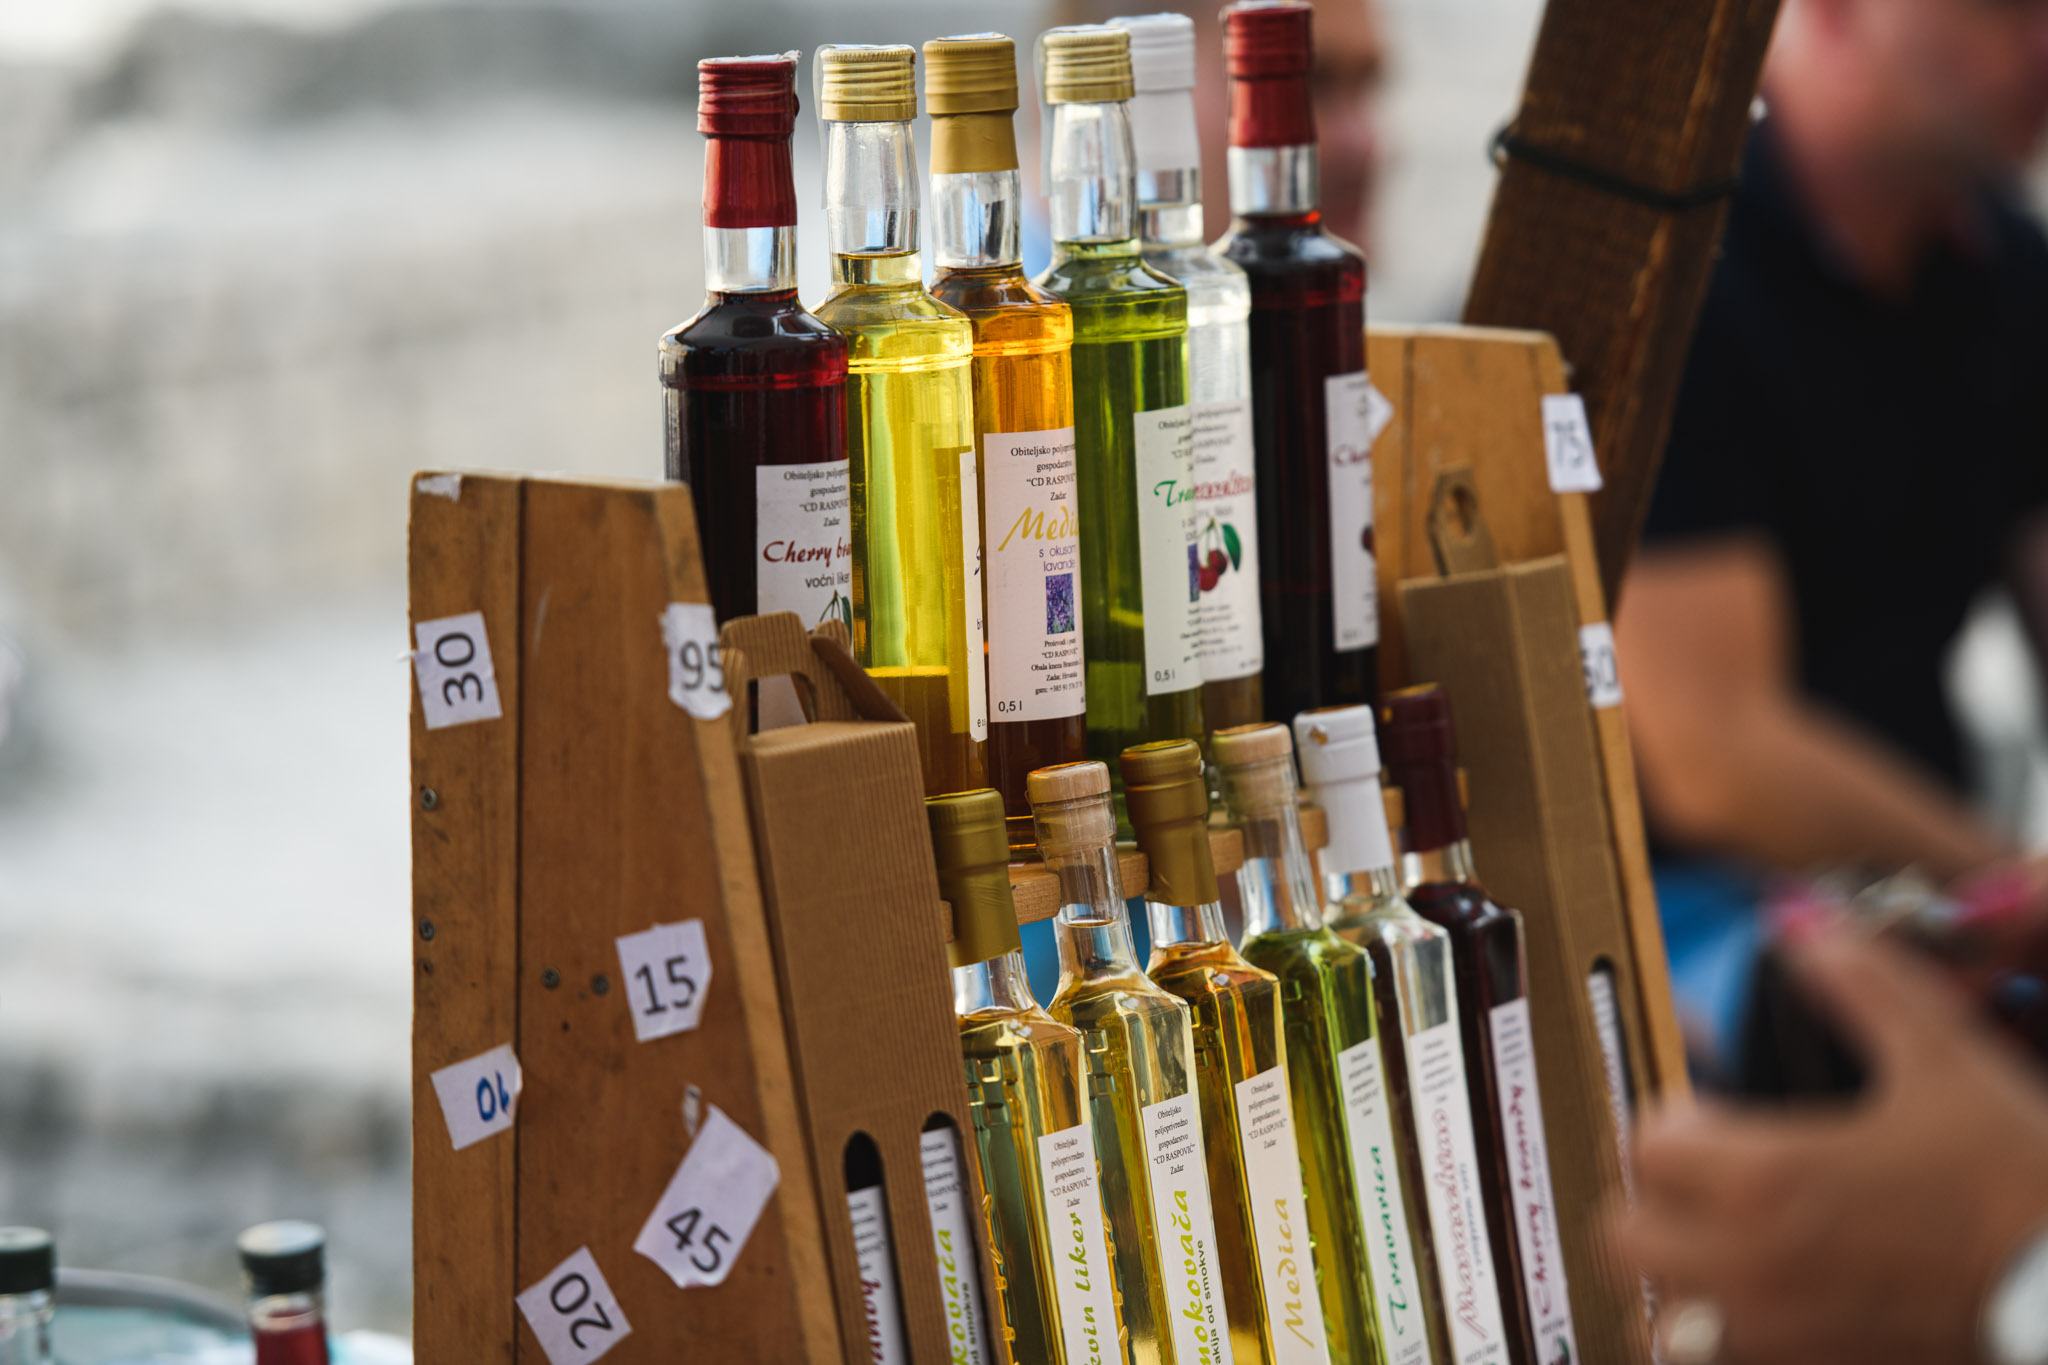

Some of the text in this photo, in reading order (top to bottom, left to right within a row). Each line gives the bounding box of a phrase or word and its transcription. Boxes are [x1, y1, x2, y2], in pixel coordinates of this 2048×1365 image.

[1010, 445, 1051, 458] Obiteljsko
[762, 540, 832, 568] Cherry
[434, 631, 484, 708] 30
[678, 641, 727, 694] 95
[998, 701, 1016, 713] 0,5
[634, 955, 697, 1016] 15
[1157, 1106, 1182, 1120] Obiteljsko
[1170, 1164, 1185, 1175] Zadar
[666, 1207, 733, 1274] 45
[1068, 1212, 1091, 1292] liker
[1197, 1240, 1212, 1300] smokve
[1274, 1198, 1316, 1349] Medica
[549, 1272, 614, 1349] 20
[1205, 1304, 1215, 1324] od
